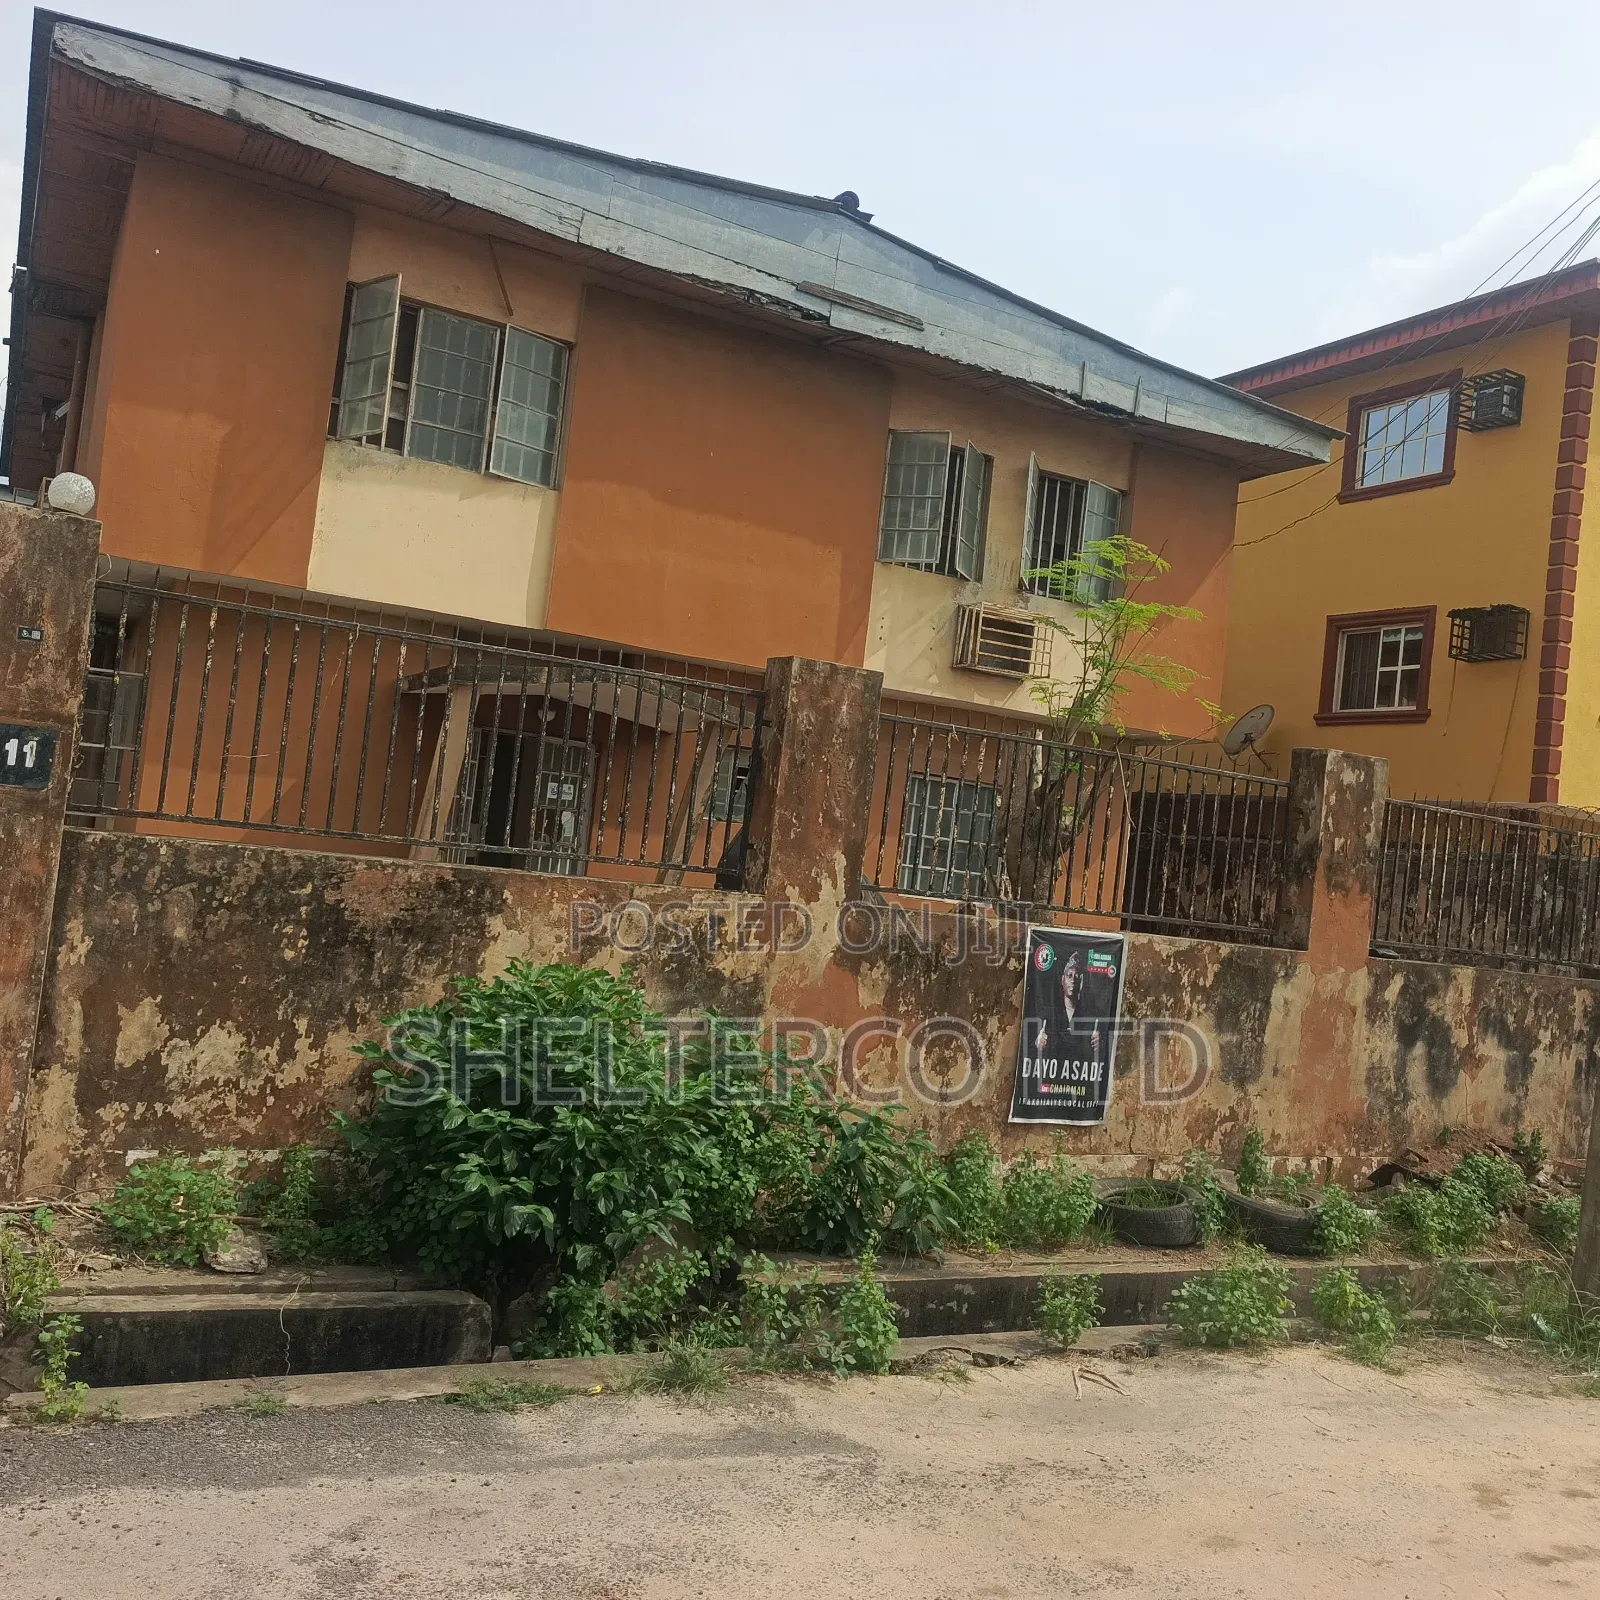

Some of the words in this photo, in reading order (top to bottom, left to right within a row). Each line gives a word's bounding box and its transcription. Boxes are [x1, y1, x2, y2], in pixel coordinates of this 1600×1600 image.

[4, 738, 37, 768] 11
[1021, 1057, 1058, 1079] DAYO
[1060, 1060, 1105, 1082] ASADE
[1049, 1083, 1086, 1096] CHAIRMAN
[1063, 1098, 1085, 1108] LOCAL
